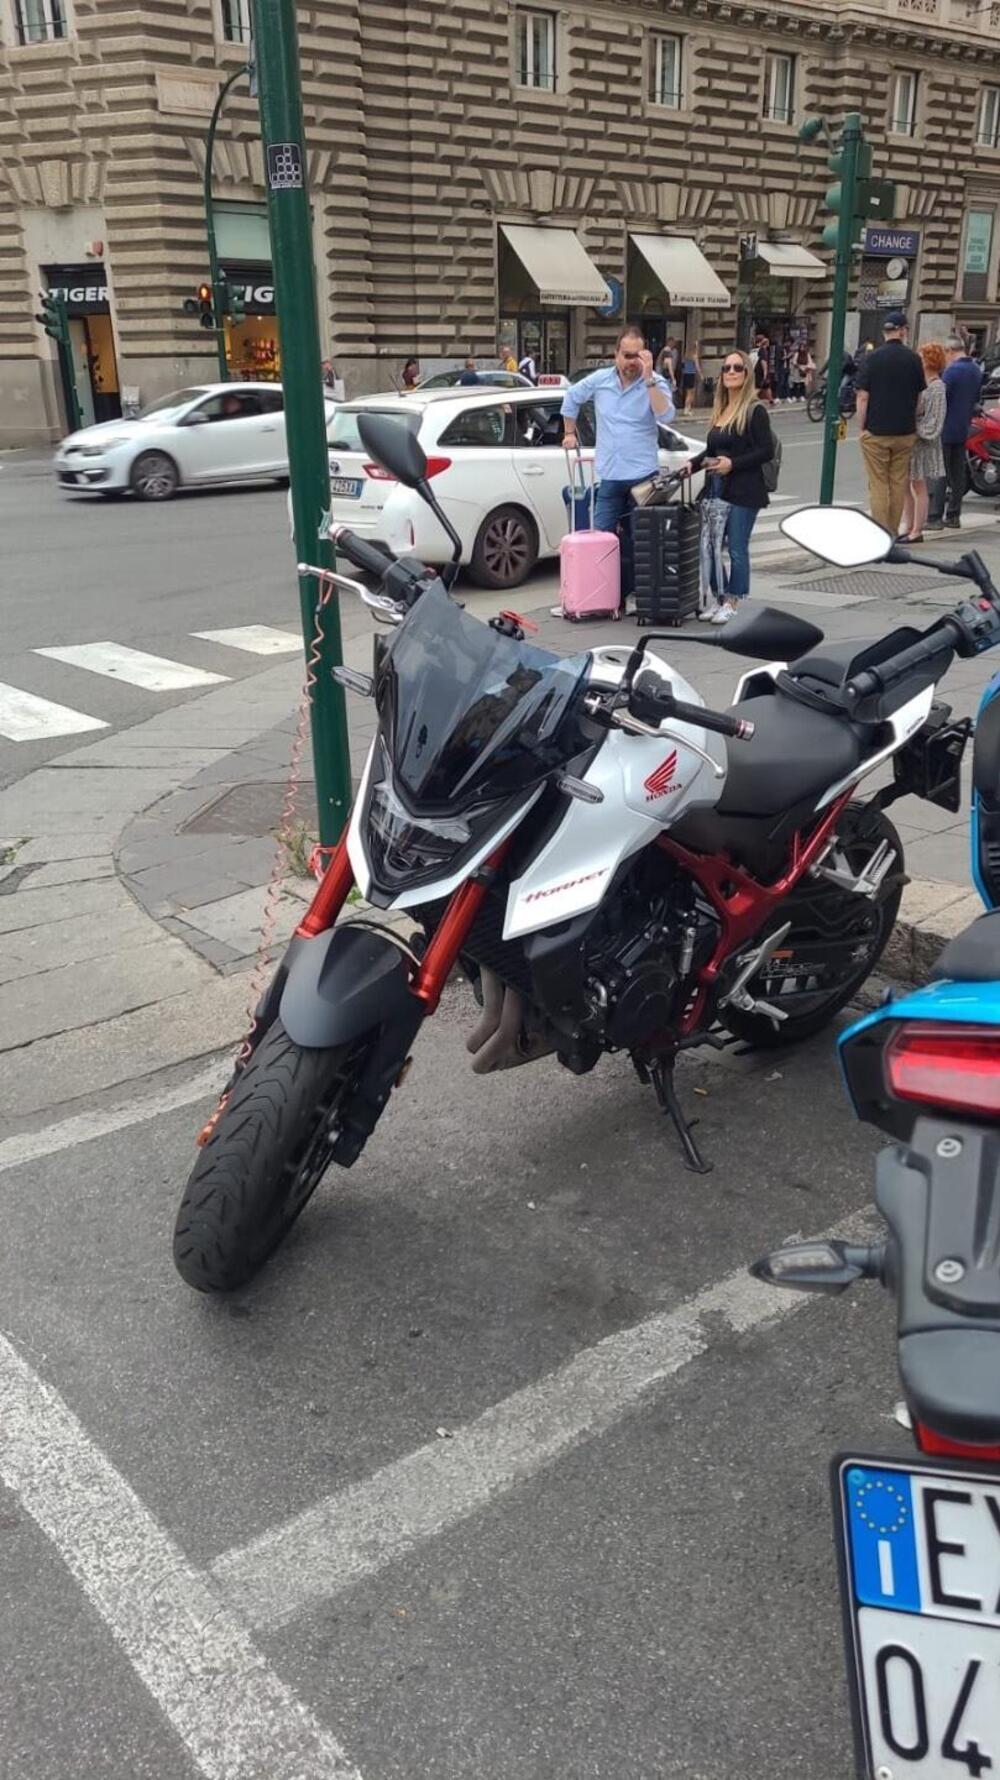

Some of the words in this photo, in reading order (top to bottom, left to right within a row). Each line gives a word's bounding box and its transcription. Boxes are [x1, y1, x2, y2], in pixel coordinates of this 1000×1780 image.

[871, 234, 913, 249] CHANGE
[48, 286, 109, 302] TIGER
[646, 783, 682, 802] HONDA
